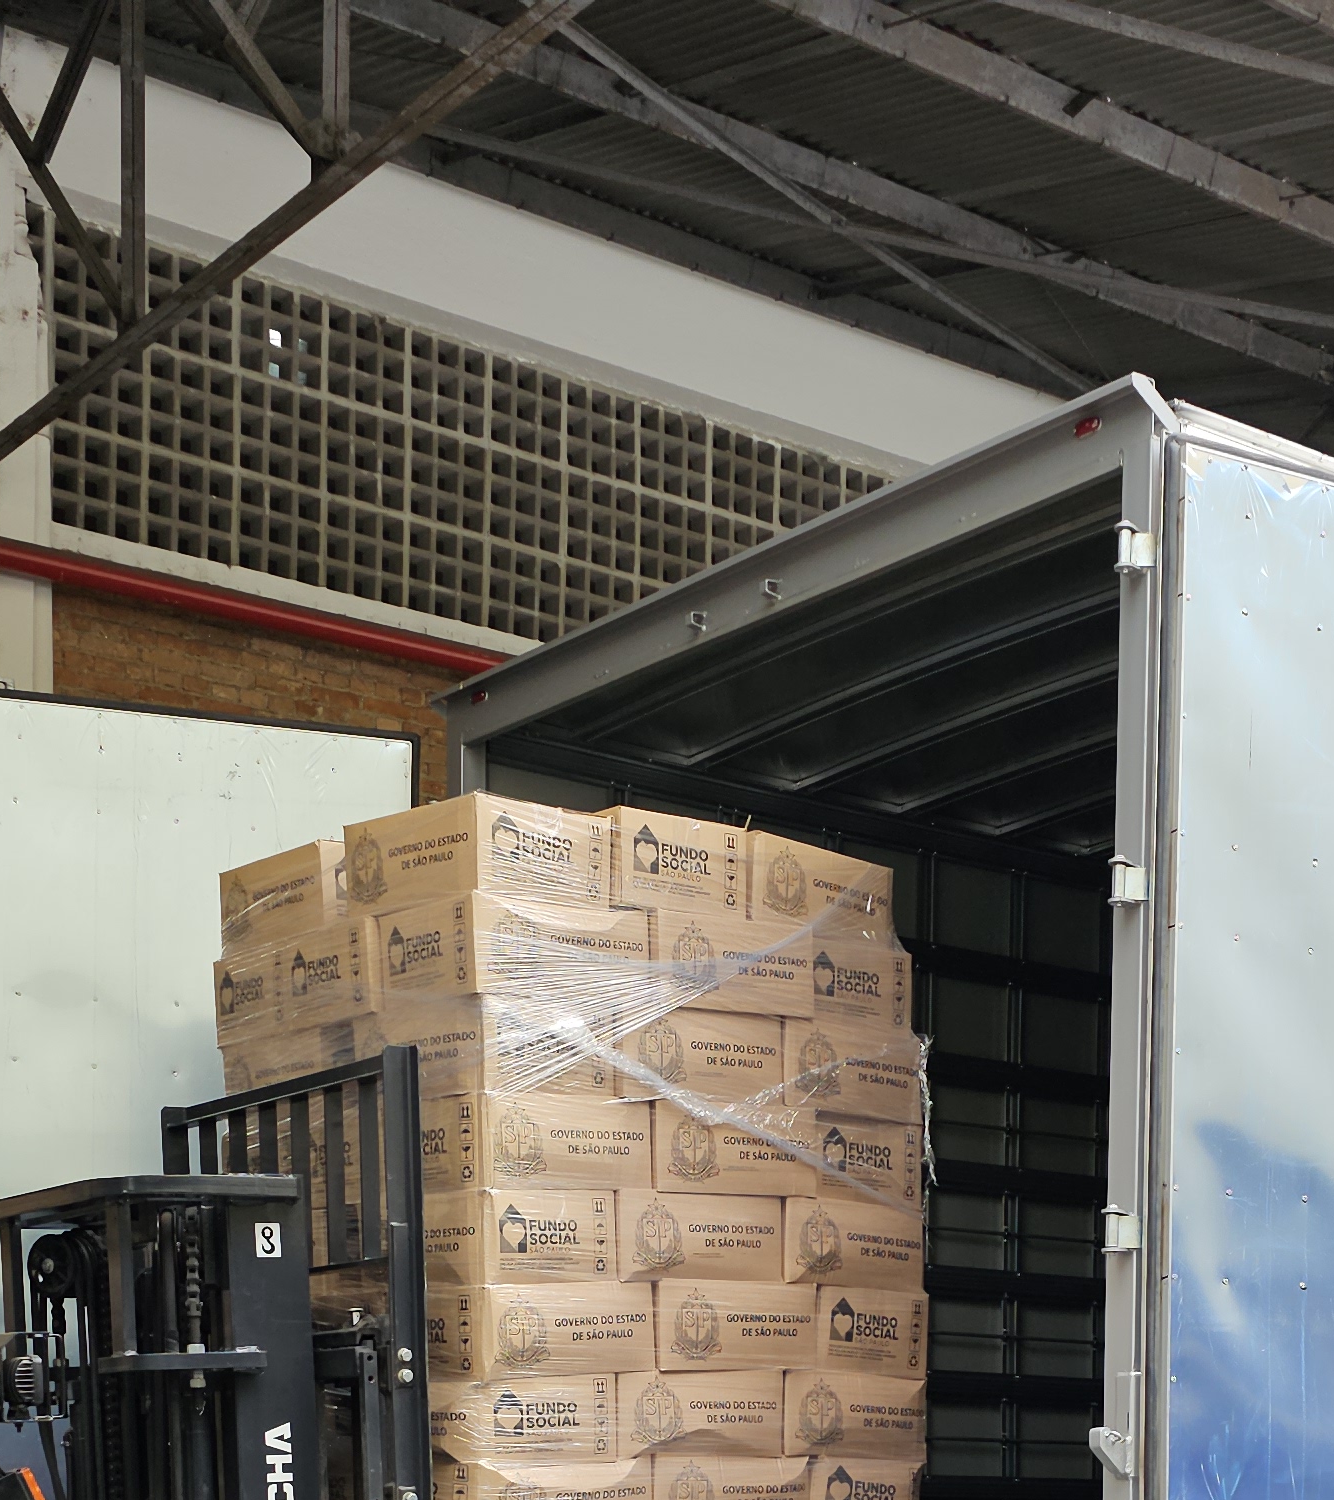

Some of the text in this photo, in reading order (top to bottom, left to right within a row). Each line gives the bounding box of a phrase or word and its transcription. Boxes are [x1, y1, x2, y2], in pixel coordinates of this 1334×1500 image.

[389, 832, 469, 858] GOVERNO DO ESTADO
[661, 843, 709, 862] FUNDO
[401, 850, 453, 870] DE SÃO PAULO
[661, 856, 711, 876] SOCIAL
[661, 868, 701, 882] SÃO PAULO
[405, 931, 441, 949] FUNDO
[551, 934, 643, 952] GOVERNO DO ESTADO
[407, 942, 443, 964] SOCIAL
[723, 950, 807, 968] GOVERNO DO ESTADO
[308, 954, 339, 973] FUNDO
[308, 965, 341, 986] SOCIAL
[739, 966, 794, 980] DE SÃO PAULO
[837, 969, 879, 986] FUNDO
[836, 980, 881, 997] SOCIAL
[691, 1041, 776, 1056] GOVERNO DO ESTADO
[707, 1056, 763, 1068] DE SÃO PAULO
[551, 1130, 644, 1141] GOVERNO DO ESTADO
[568, 1142, 630, 1156] DE SÃO PAULO
[849, 1143, 891, 1158] FUNDO
[849, 1154, 893, 1170] SOCIAL
[530, 1220, 577, 1232] FUNDO
[689, 1224, 774, 1235] GOVERNO DO ESTADO
[530, 1232, 580, 1246] SOCIAL
[705, 1237, 761, 1248] DE SÃO PAULO
[847, 1232, 920, 1250] GOVERNO DO ESTADO
[861, 1248, 909, 1261] DE SÃO PAULO
[555, 1314, 646, 1328] GOVERNO DO ESTADO
[727, 1314, 811, 1324] GOVERNO DO ESTADO
[857, 1312, 897, 1328] FUNDO
[573, 1328, 633, 1341] DE SÃO PAULO
[742, 1326, 797, 1337] DE SÃO PAULO
[855, 1325, 899, 1340] SOCIAL
[526, 1402, 577, 1415] FUNDO
[689, 1401, 777, 1410] GOVERNO DO ESTADO
[526, 1414, 580, 1428] SOCIAL
[707, 1413, 763, 1424] DE SÃO PAULO
[855, 1480, 896, 1496] FUNDO
